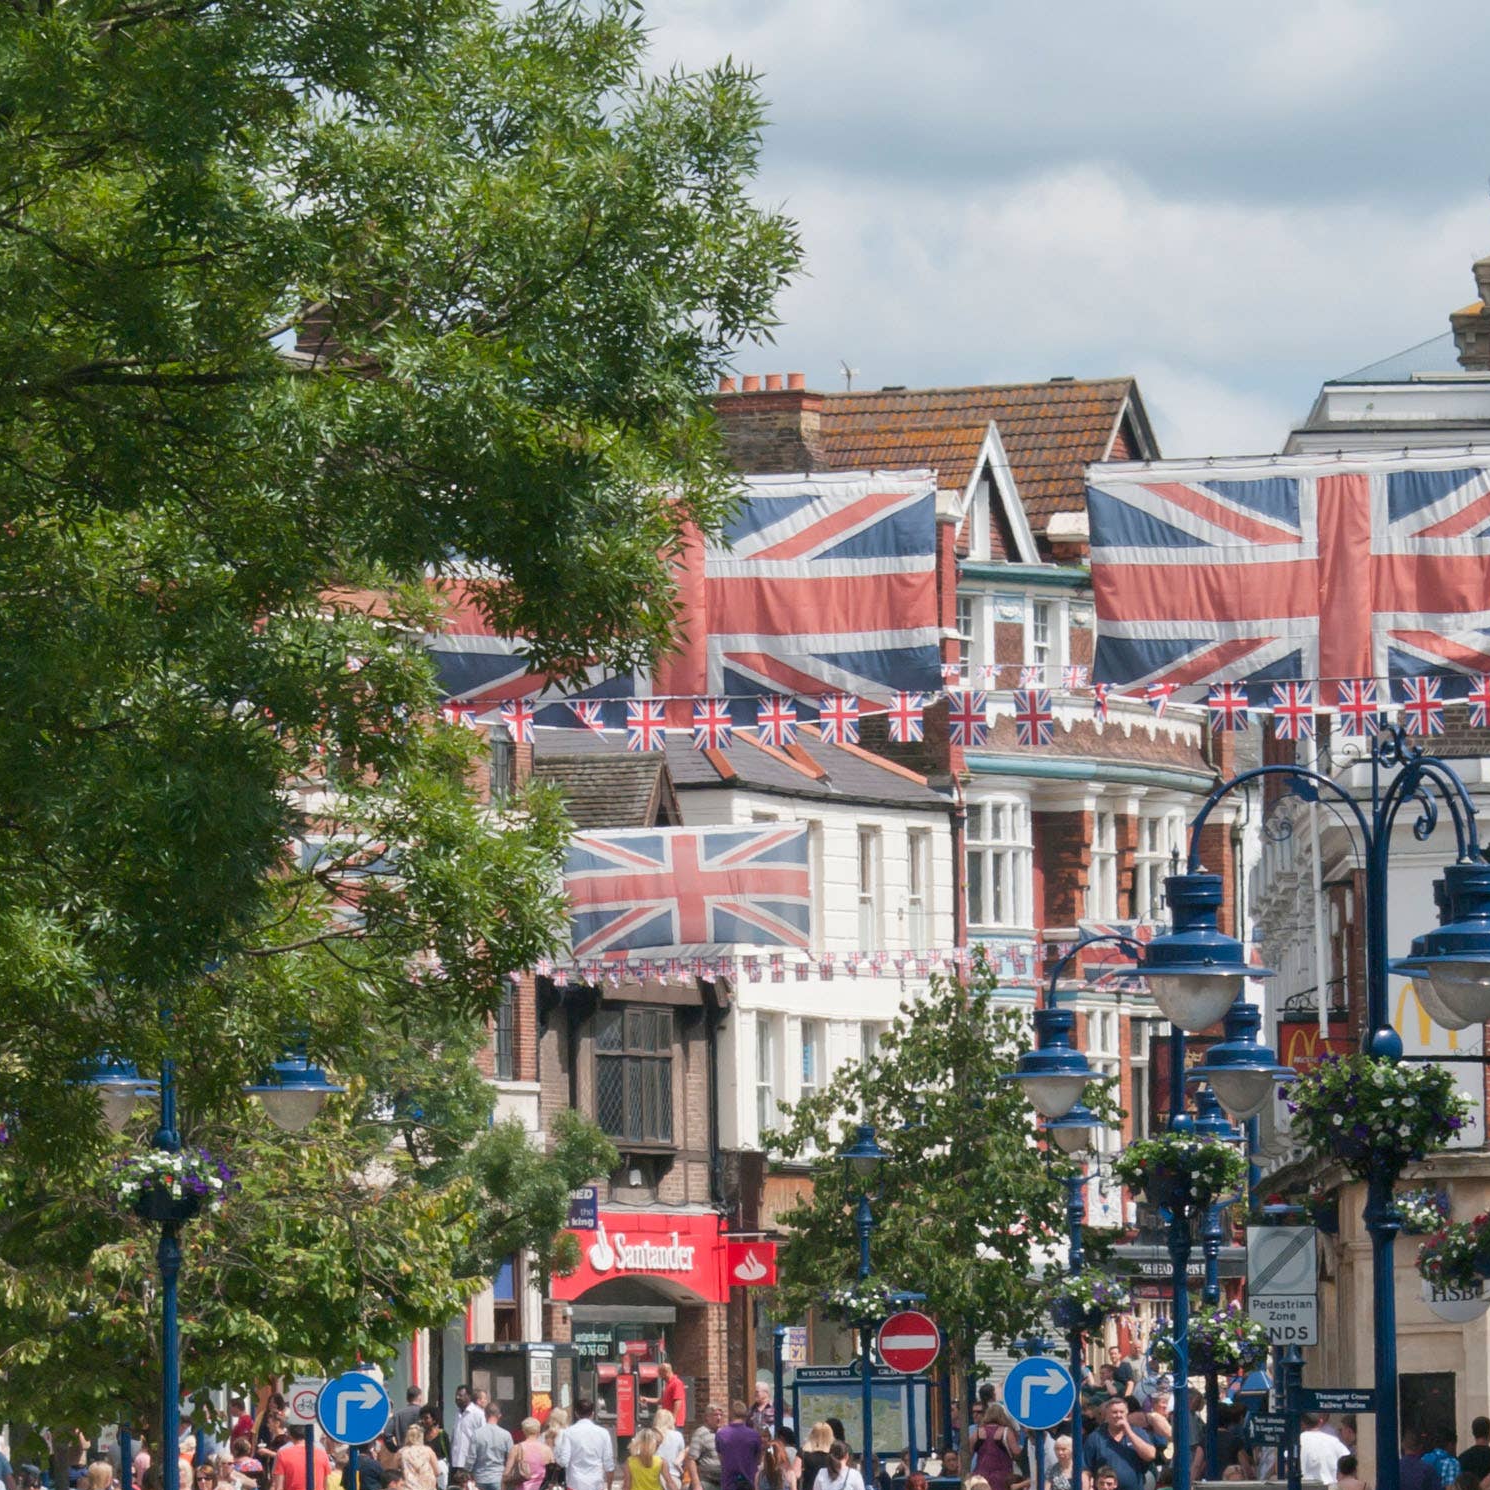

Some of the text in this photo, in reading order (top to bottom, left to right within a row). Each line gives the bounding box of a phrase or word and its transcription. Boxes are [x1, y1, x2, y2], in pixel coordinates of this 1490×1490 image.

[614, 1231, 695, 1271] Santander
[1252, 1299, 1313, 1310] Pedestrian
[1269, 1311, 1297, 1321] Zone
[1267, 1326, 1309, 1341] NDS
